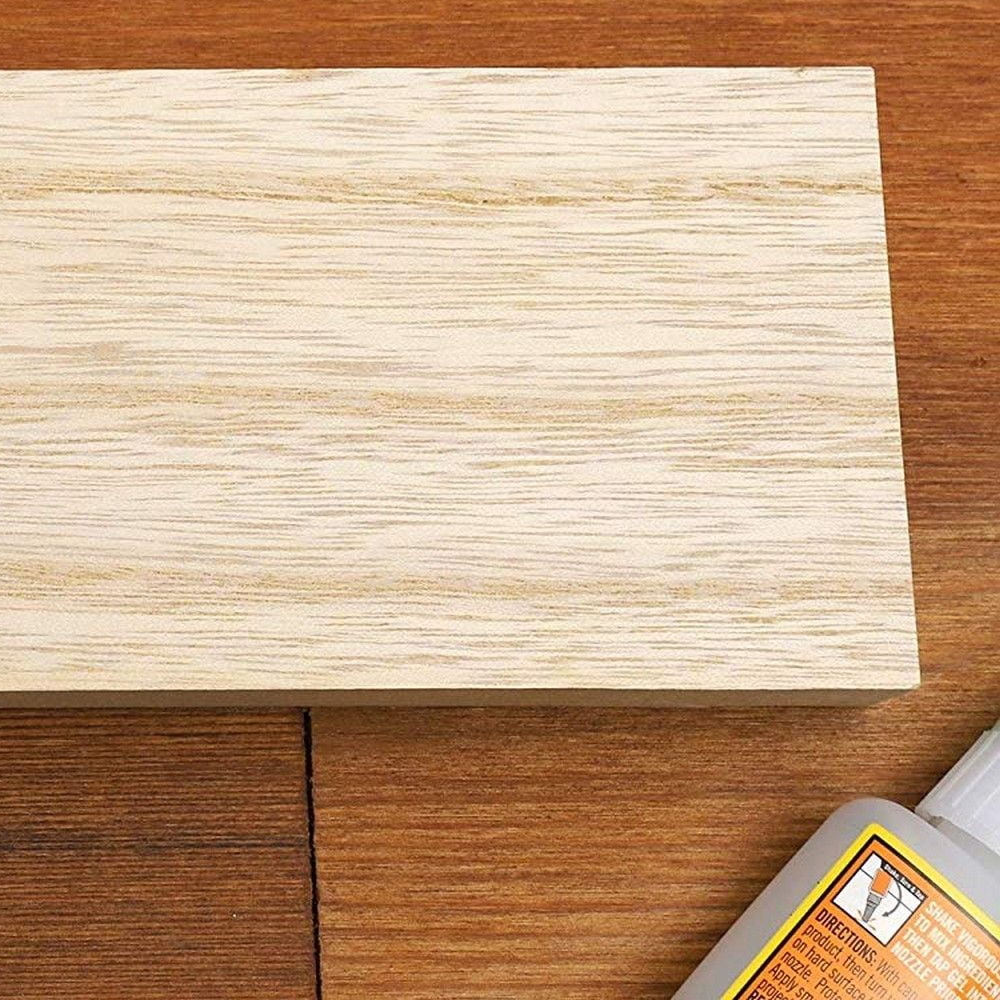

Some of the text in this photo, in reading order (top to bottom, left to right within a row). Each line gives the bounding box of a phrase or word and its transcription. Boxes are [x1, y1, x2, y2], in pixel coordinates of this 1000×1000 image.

[780, 951, 812, 982] nozzle.
[792, 938, 866, 1000] on hard surface
[801, 924, 887, 999] product, then turn
[815, 908, 877, 966] DIRECTIONS:
[876, 958, 900, 985] With
[890, 942, 932, 982] NOZZLE
[903, 928, 933, 957] THEN
[930, 950, 951, 972] TAP
[947, 968, 967, 992] GEL
[915, 914, 1000, 999] TO MIX INGREDIEN
[925, 901, 1000, 979] SHAKE VIGOROU
[768, 963, 799, 992] Apply
